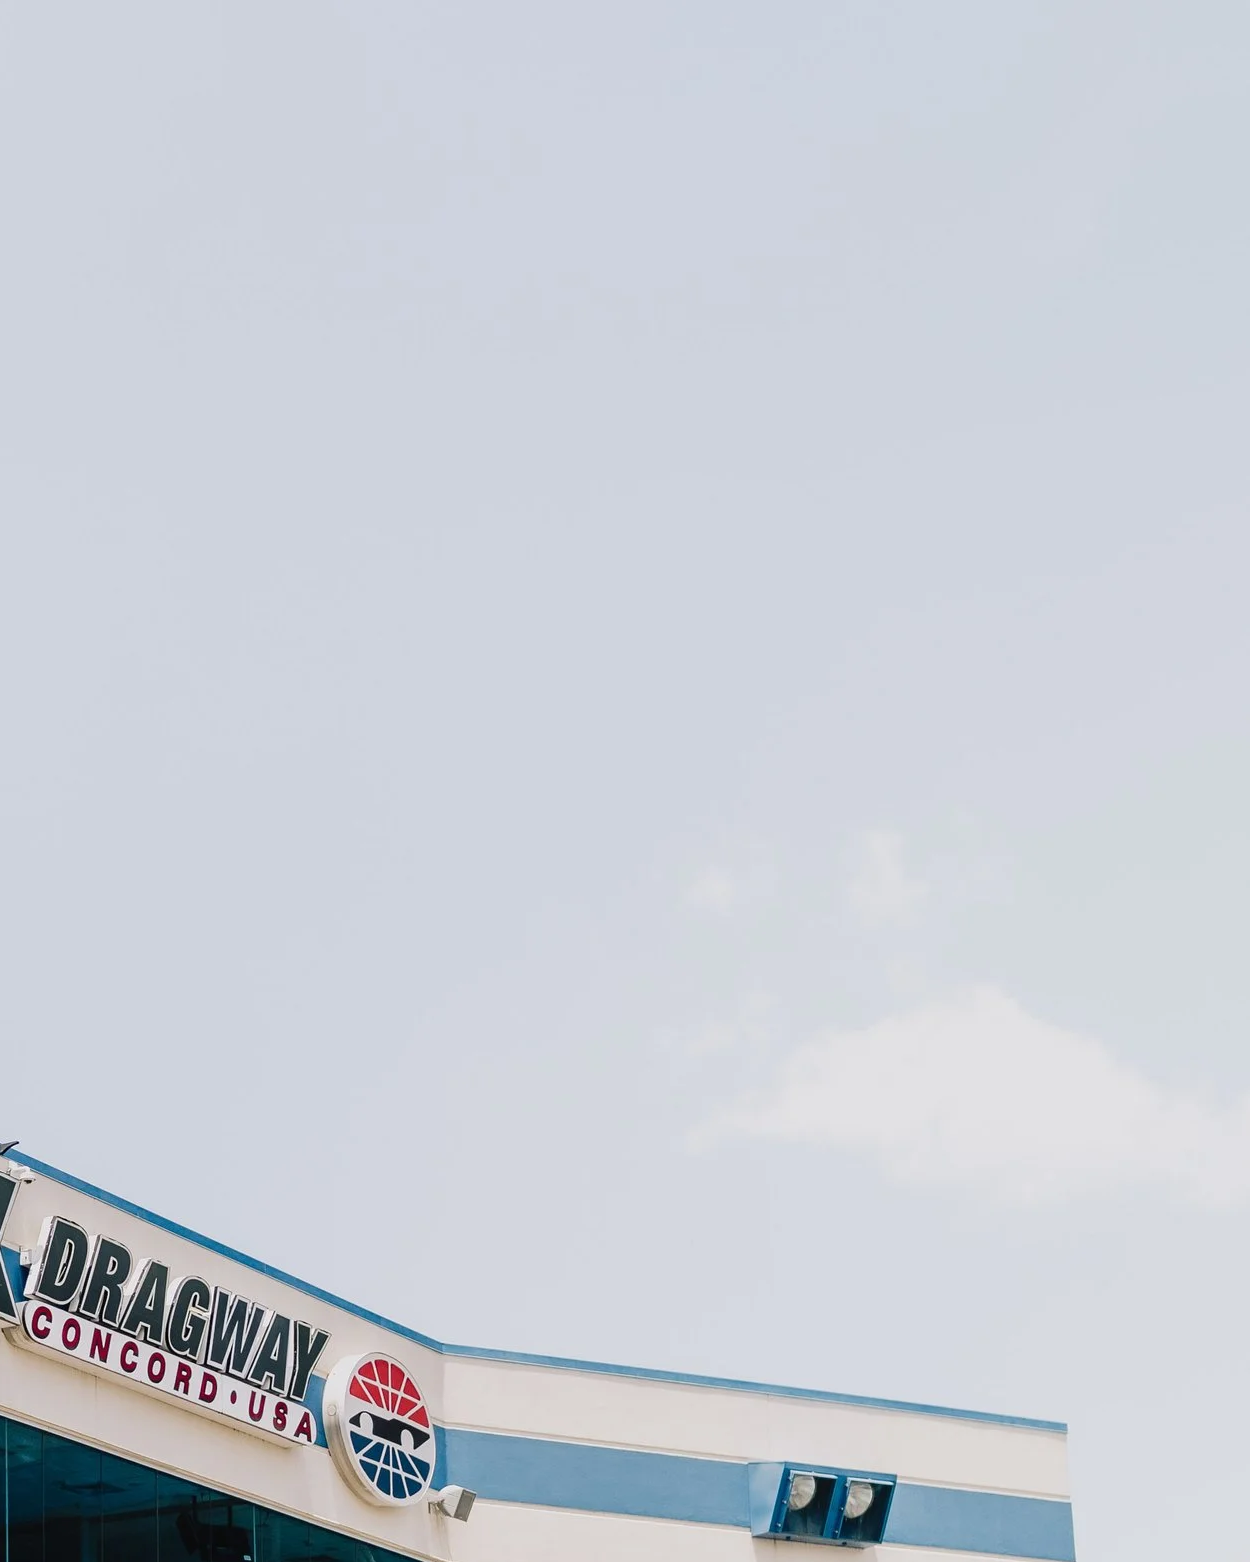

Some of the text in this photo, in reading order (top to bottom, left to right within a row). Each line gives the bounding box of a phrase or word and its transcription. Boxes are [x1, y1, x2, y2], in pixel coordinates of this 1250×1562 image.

[31, 1305, 313, 1443] CONCORD USA
[34, 1216, 332, 1401] DRAGWAY
